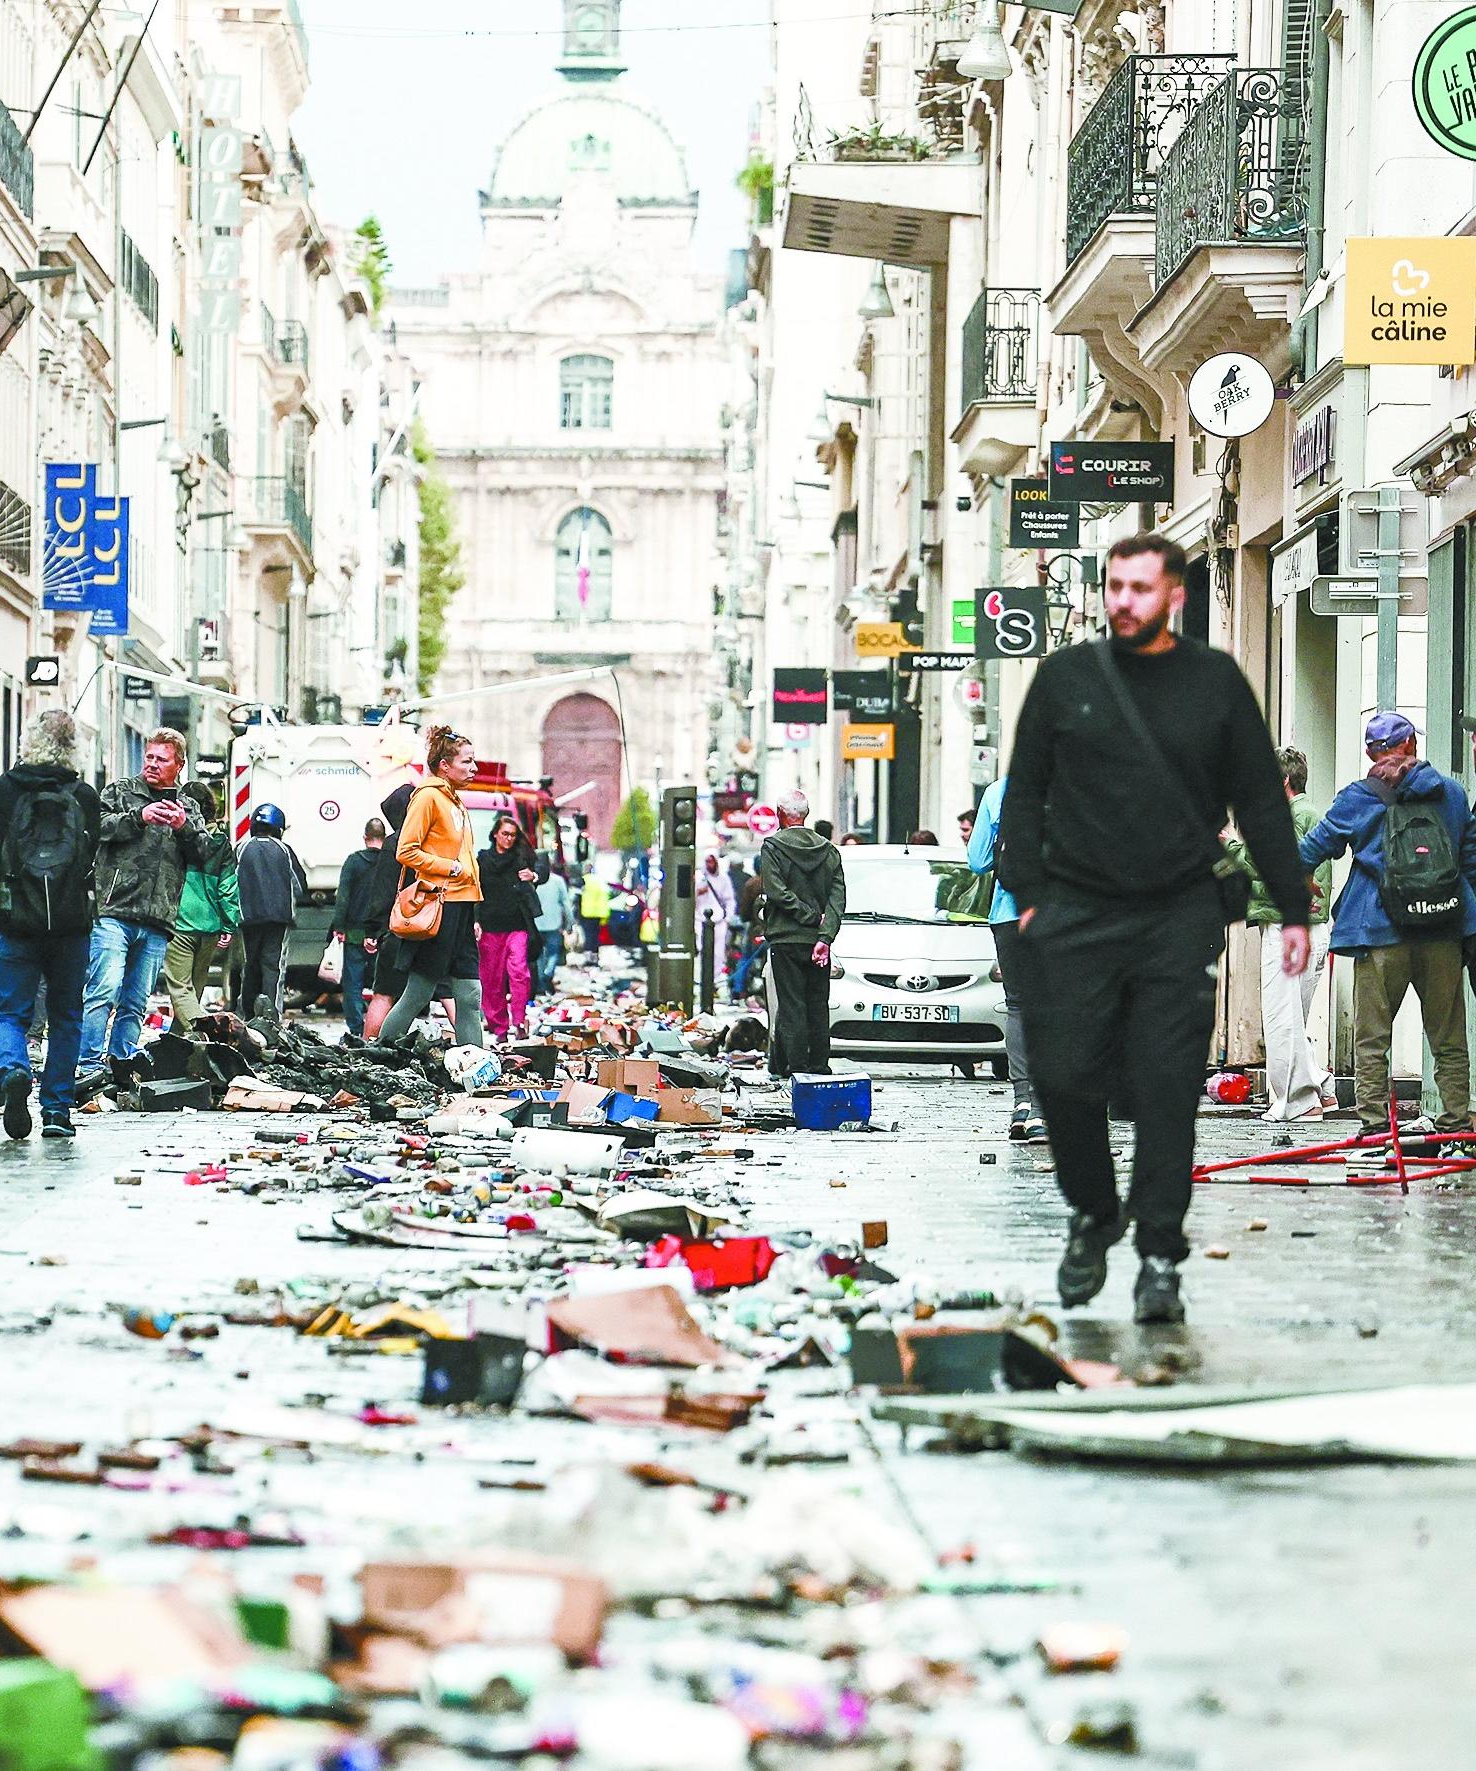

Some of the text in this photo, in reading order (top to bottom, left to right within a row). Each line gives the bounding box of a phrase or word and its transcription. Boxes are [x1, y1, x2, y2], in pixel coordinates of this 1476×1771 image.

[1442, 64, 1462, 93] LE
[1371, 295, 1448, 318] la mie
[1371, 320, 1447, 341] câline
[1218, 382, 1243, 400] OAK
[1213, 387, 1251, 413] BERRY
[1081, 459, 1152, 472] COURIR
[1015, 489, 1047, 501] LOOK
[54, 463, 87, 558] LCL
[1022, 521, 1068, 530] Chaussures
[93, 495, 122, 586] LCL
[1030, 530, 1059, 539] Enfants
[315, 766, 361, 776] schmidt
[324, 806, 335, 815] 25
[1407, 897, 1459, 914] ellesse
